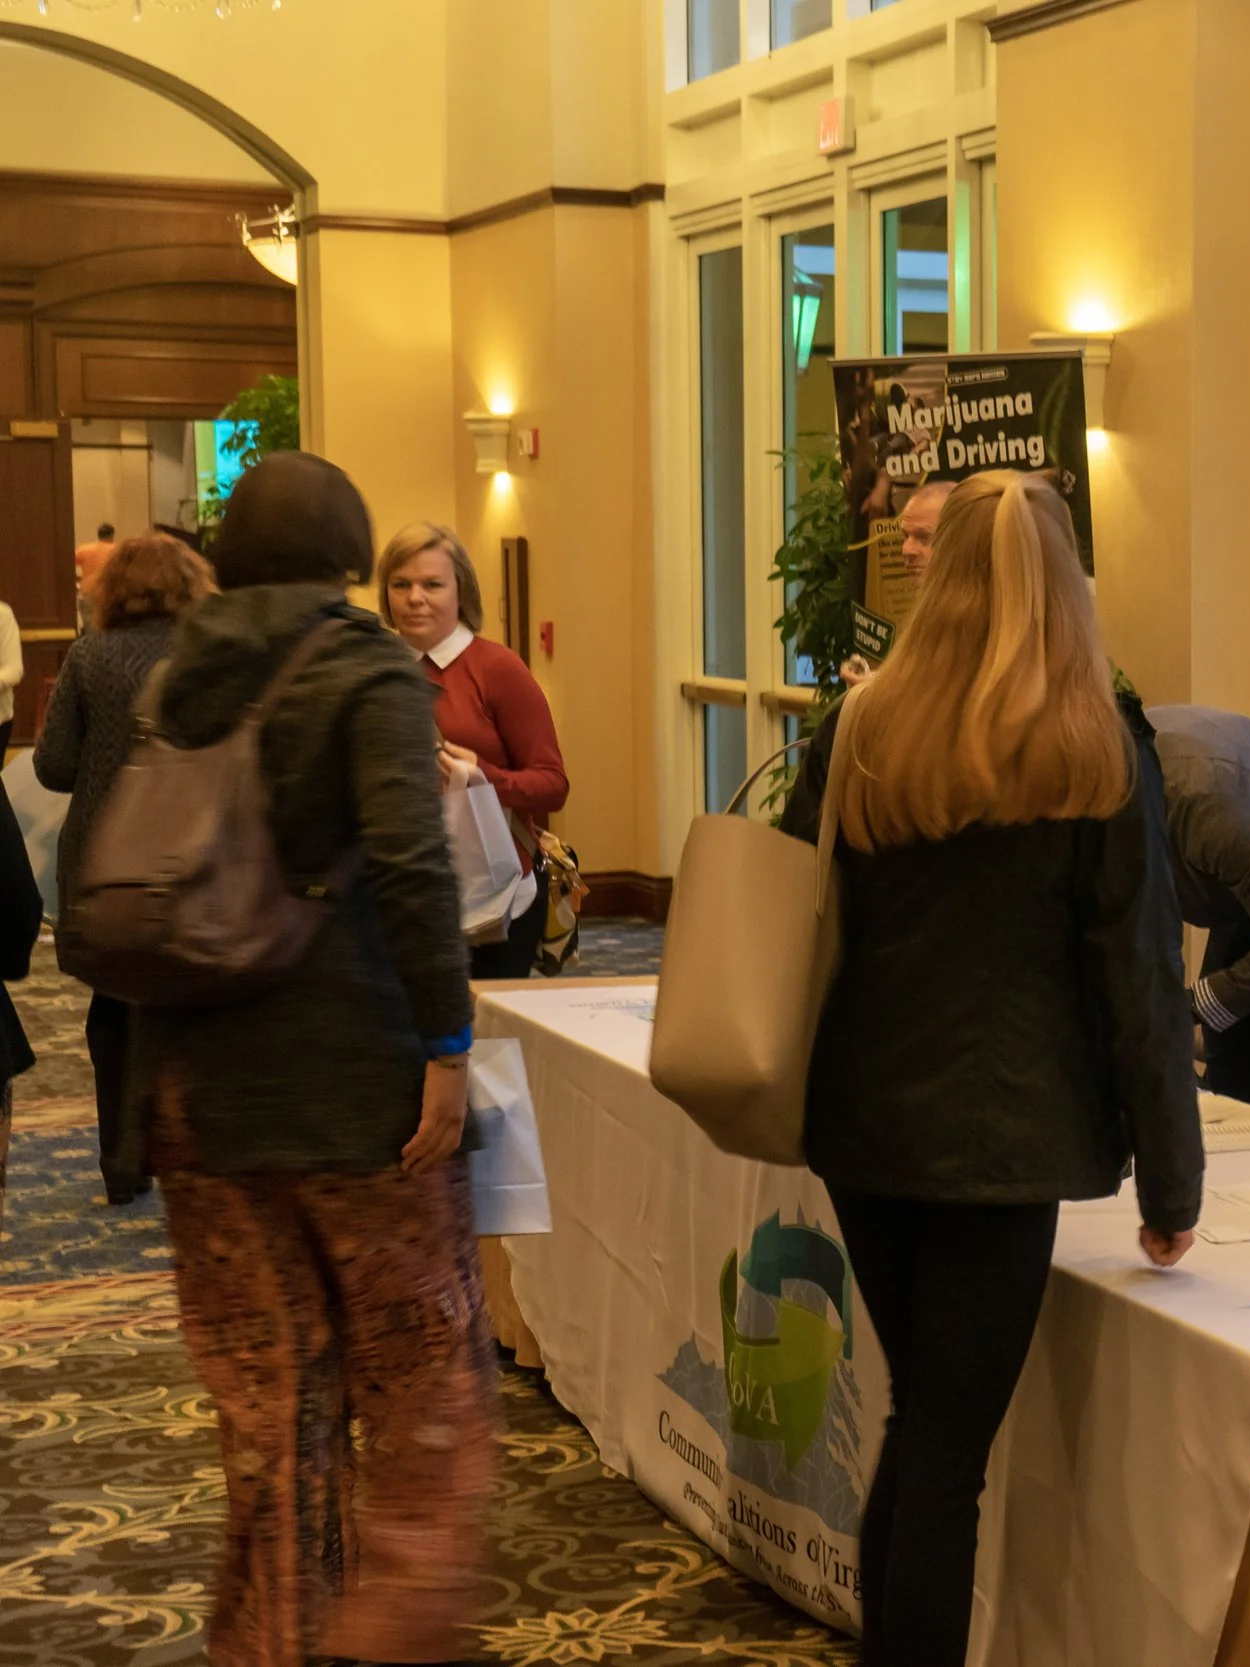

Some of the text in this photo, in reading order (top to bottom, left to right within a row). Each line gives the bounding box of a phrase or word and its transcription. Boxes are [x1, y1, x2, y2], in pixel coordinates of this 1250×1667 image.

[886, 391, 1033, 434] Marijuana
[886, 429, 1046, 477] and Driving
[876, 522, 900, 534] Drivi
